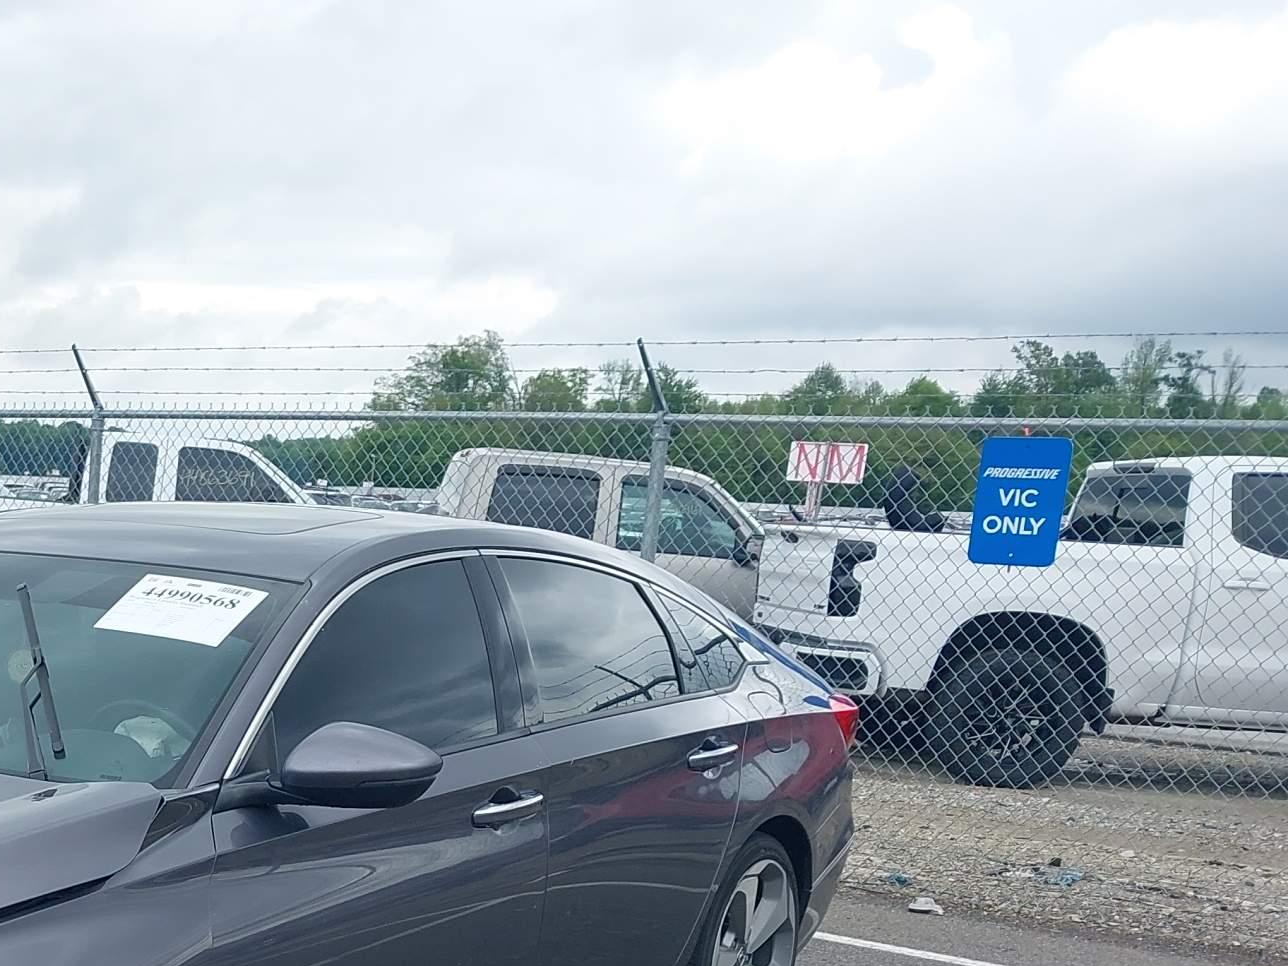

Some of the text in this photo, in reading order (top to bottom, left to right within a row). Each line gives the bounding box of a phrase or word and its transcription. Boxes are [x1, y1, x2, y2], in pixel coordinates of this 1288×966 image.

[983, 467, 1062, 479] PROGRESSIVE
[999, 488, 1039, 507] VIC
[983, 515, 1046, 535] ONLY
[142, 586, 241, 610] 44990568
